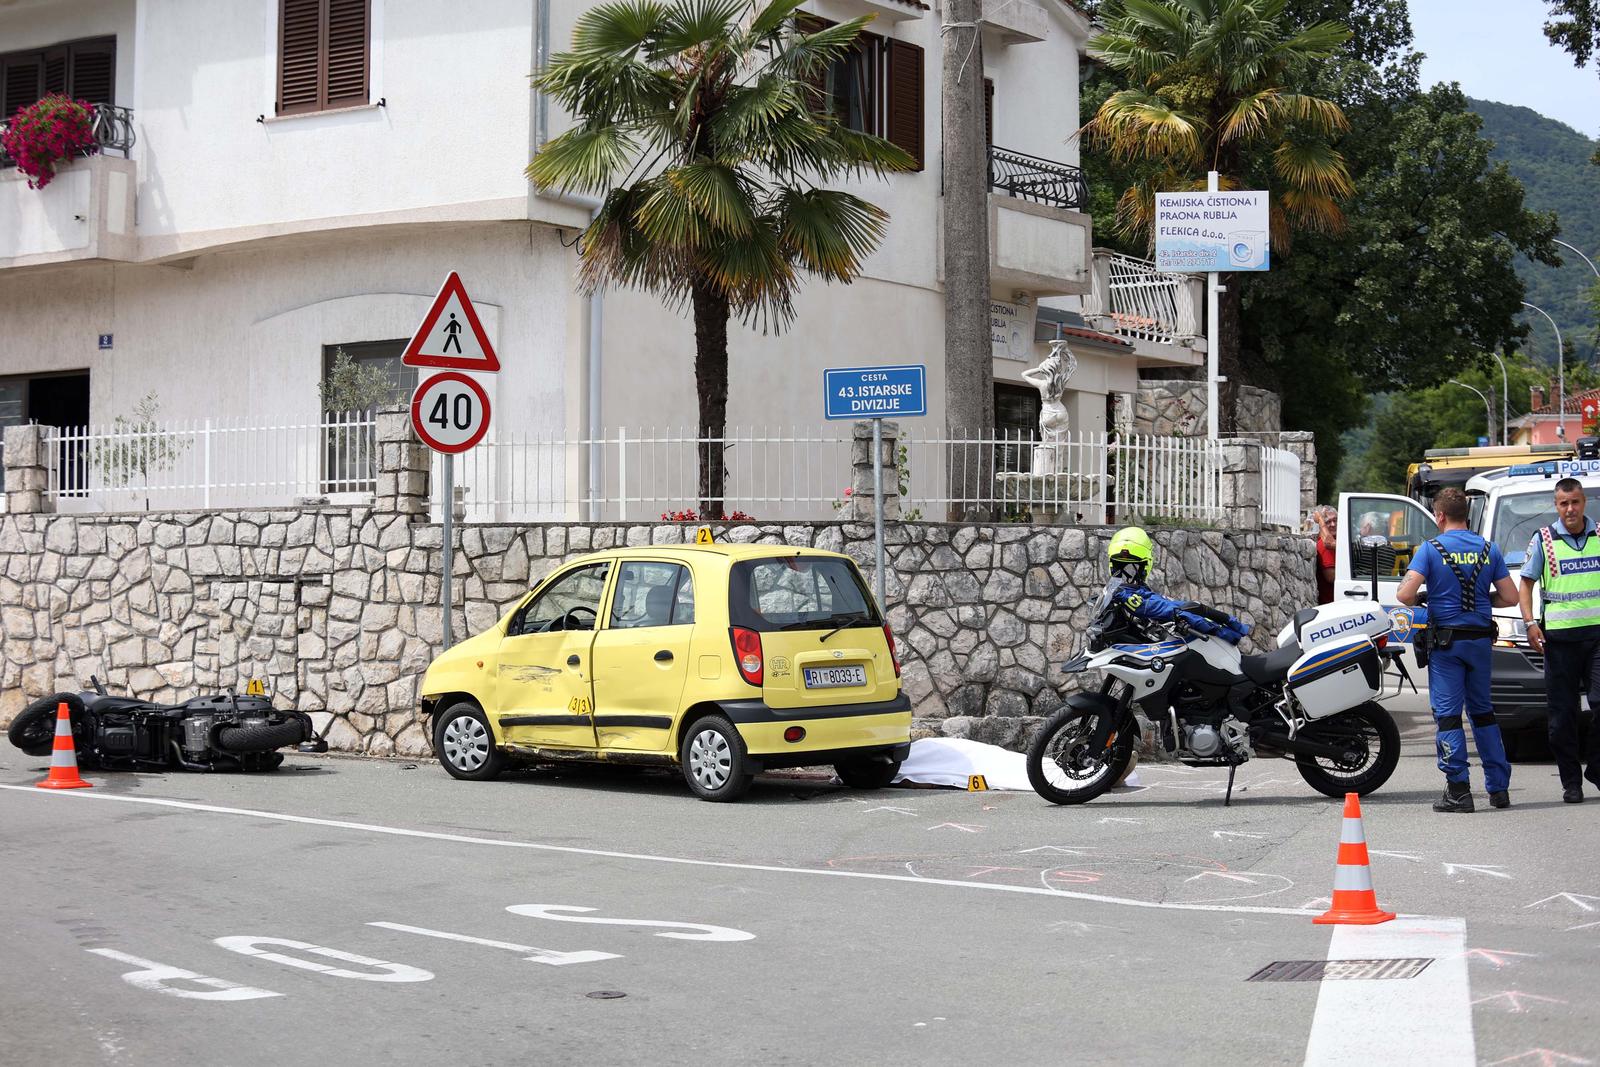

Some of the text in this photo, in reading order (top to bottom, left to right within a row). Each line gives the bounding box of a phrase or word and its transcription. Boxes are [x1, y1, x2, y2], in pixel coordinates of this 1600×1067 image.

[1160, 198, 1205, 208] KEMIJSKA
[1207, 196, 1251, 207] ČISTIONA
[1160, 211, 1237, 220] PRAONA RUBLJA
[1160, 227, 1226, 240] FLEKICA d.o.o.
[861, 374, 888, 382] CESTA
[851, 398, 900, 411] DIVIZIJE
[428, 393, 472, 430] 40
[700, 528, 707, 543] 2
[1443, 552, 1490, 565] OLICIA
[1561, 560, 1600, 571] POLICIJA
[1310, 613, 1376, 642] POLICIJA
[812, 671, 823, 684] RI
[252, 679, 260, 692] 1
[581, 699, 586, 713] 3
[972, 776, 980, 789] 6
[85, 903, 756, 1001] STOP
